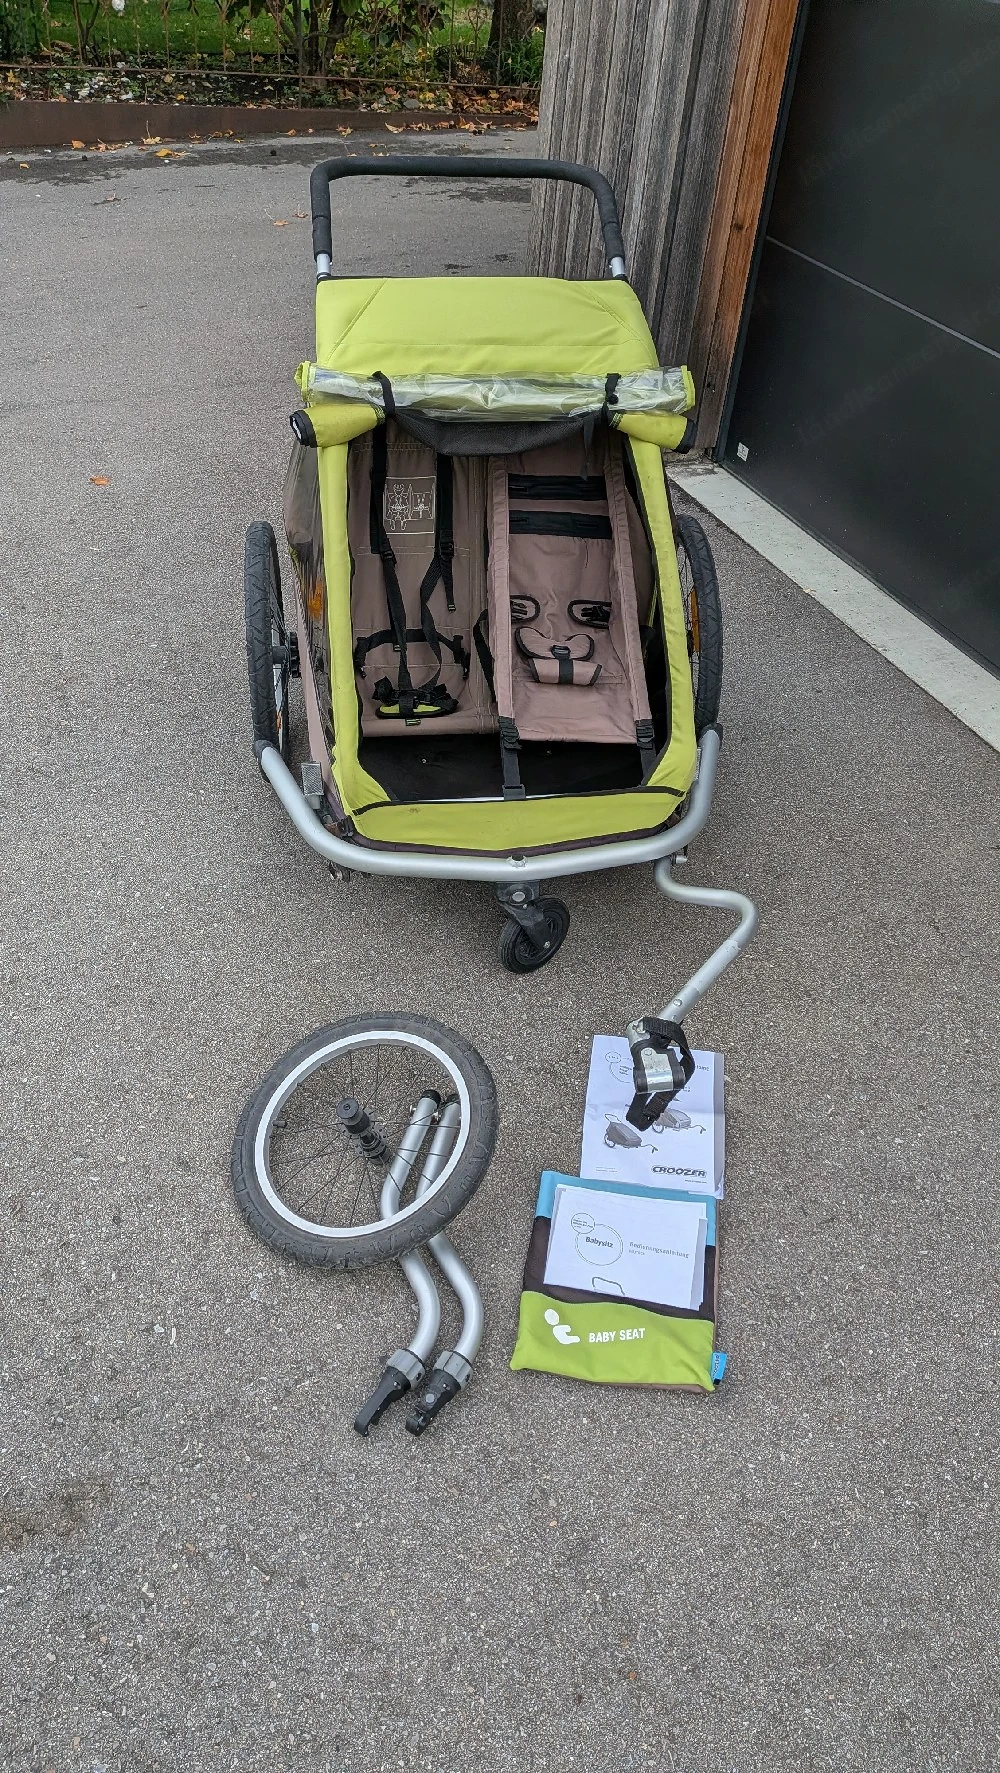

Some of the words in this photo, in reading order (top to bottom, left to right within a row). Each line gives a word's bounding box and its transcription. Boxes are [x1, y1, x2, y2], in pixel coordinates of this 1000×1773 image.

[652, 1165, 707, 1178] CROOZER
[585, 1236, 614, 1249] Babysitz
[588, 1331, 616, 1343] BABY
[619, 1328, 646, 1341] SEAT
